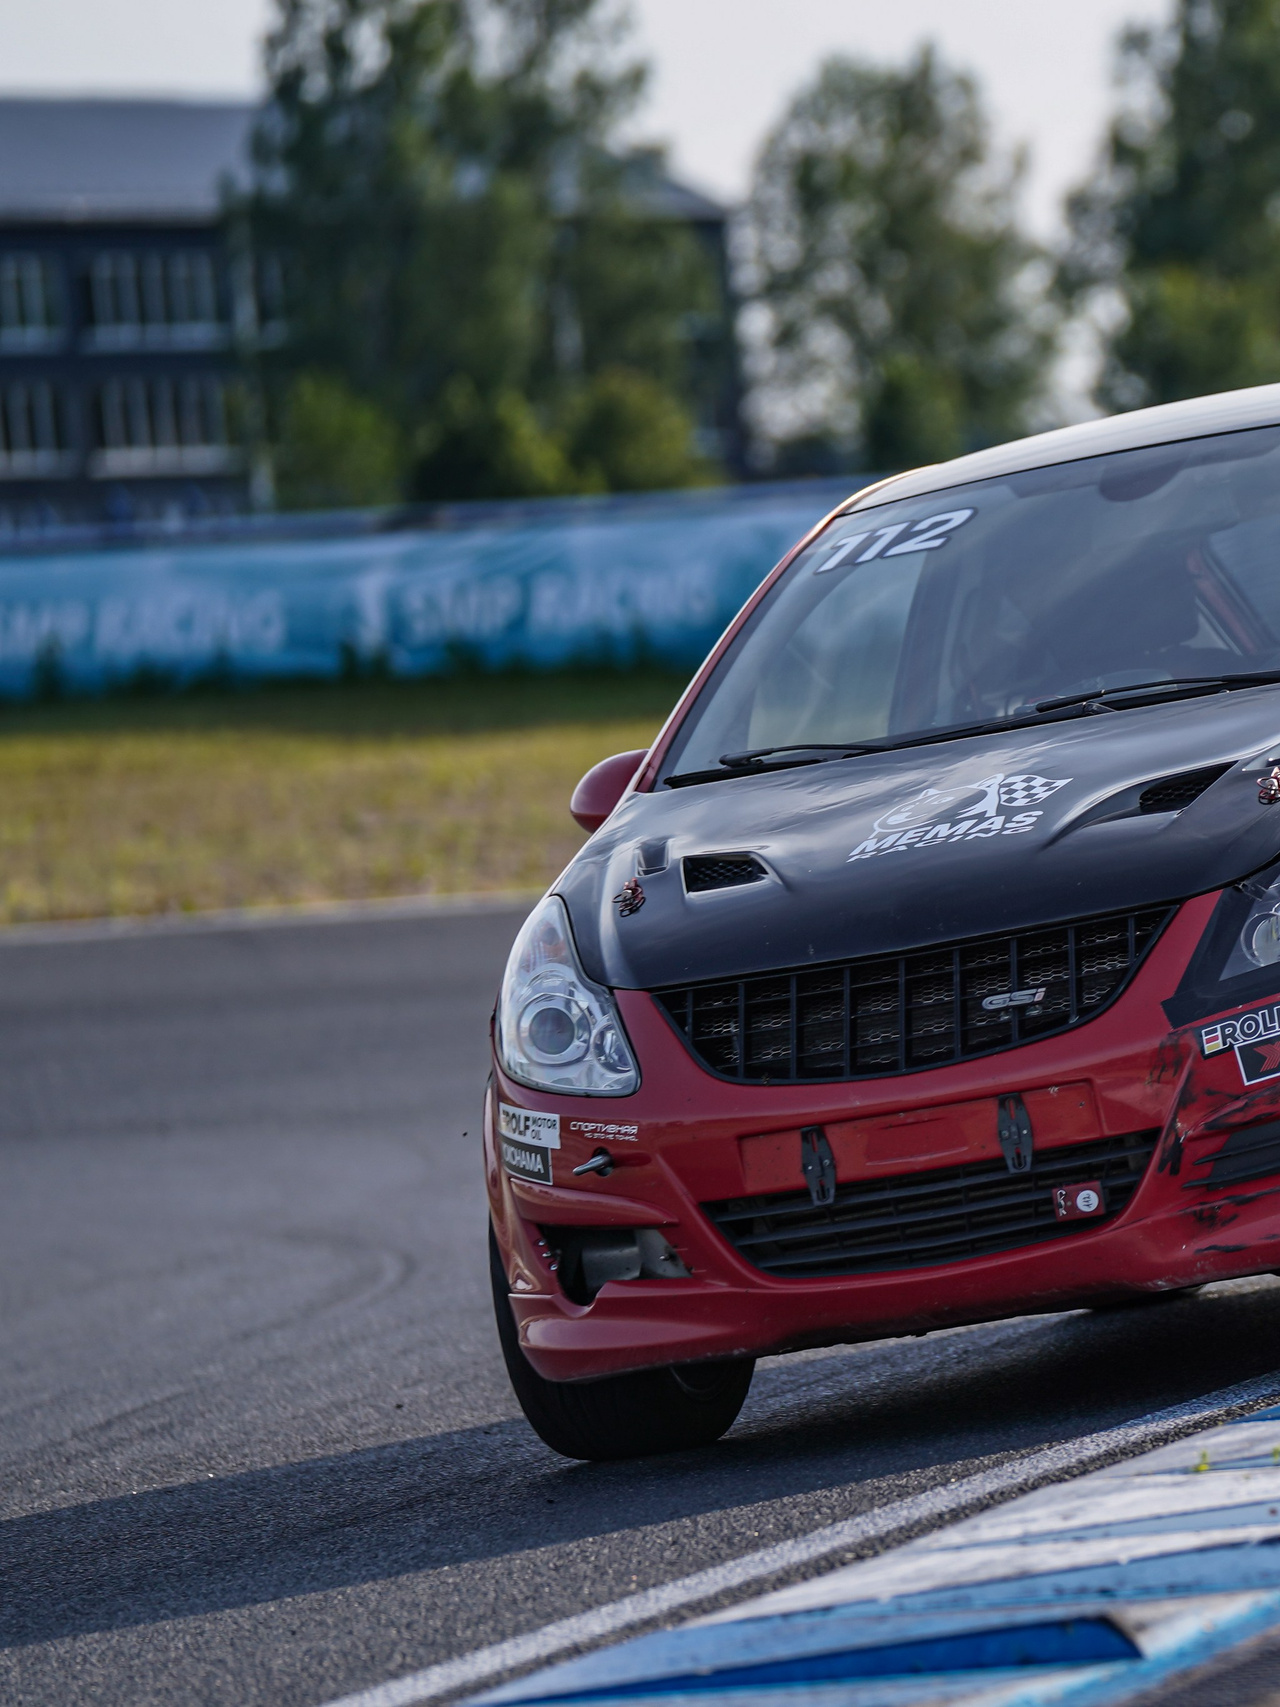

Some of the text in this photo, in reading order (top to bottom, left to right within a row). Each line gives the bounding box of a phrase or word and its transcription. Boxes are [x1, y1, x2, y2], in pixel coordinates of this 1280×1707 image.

[815, 507, 975, 574] 112
[0, 600, 88, 655] MP
[845, 825, 1035, 863] RACING
[848, 810, 1044, 857] MEMAS
[531, 1115, 558, 1130] MOTOR
[531, 1129, 542, 1141] OIL
[569, 1121, 639, 1134] СПОРТИВНАЯ
